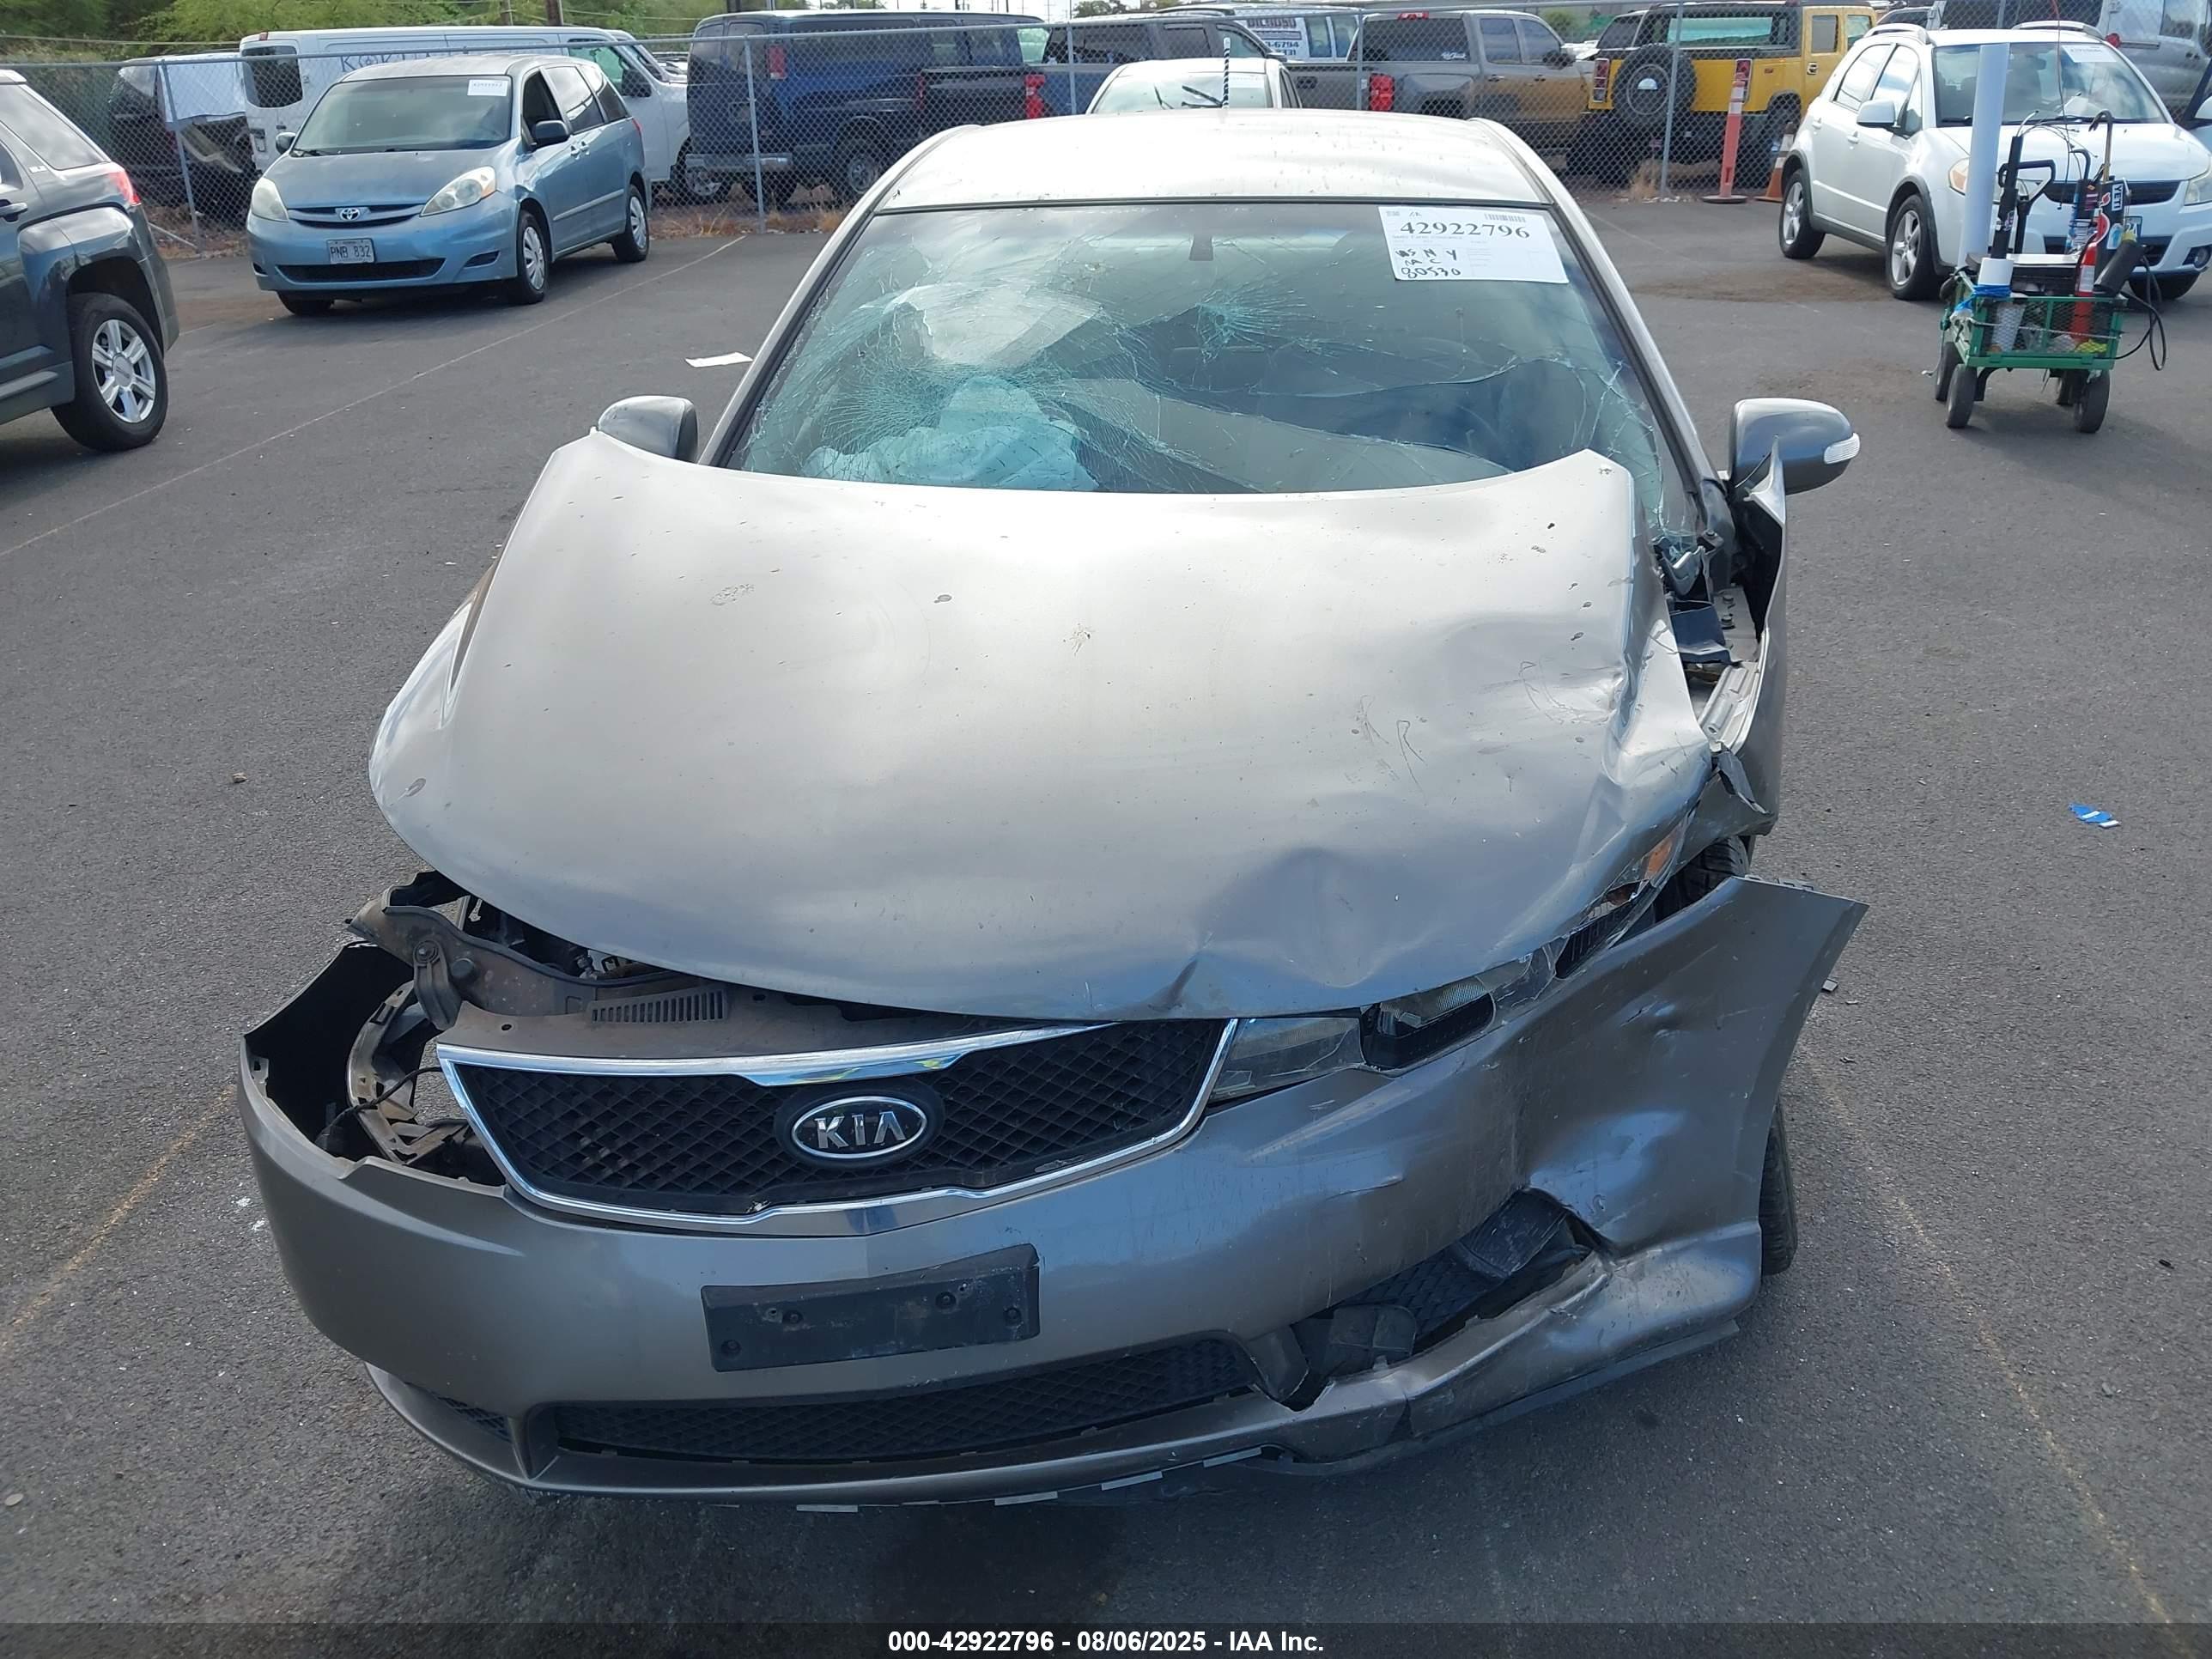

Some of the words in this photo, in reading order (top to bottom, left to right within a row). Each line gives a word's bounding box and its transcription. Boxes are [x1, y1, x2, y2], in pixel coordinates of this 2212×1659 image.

[2113, 185, 2123, 211] YETI
[1401, 222, 1530, 239] 42922796
[330, 246, 349, 258] PNB
[353, 245, 371, 258] 832
[1401, 266, 1461, 279] 80530
[814, 1110, 907, 1149] KIA
